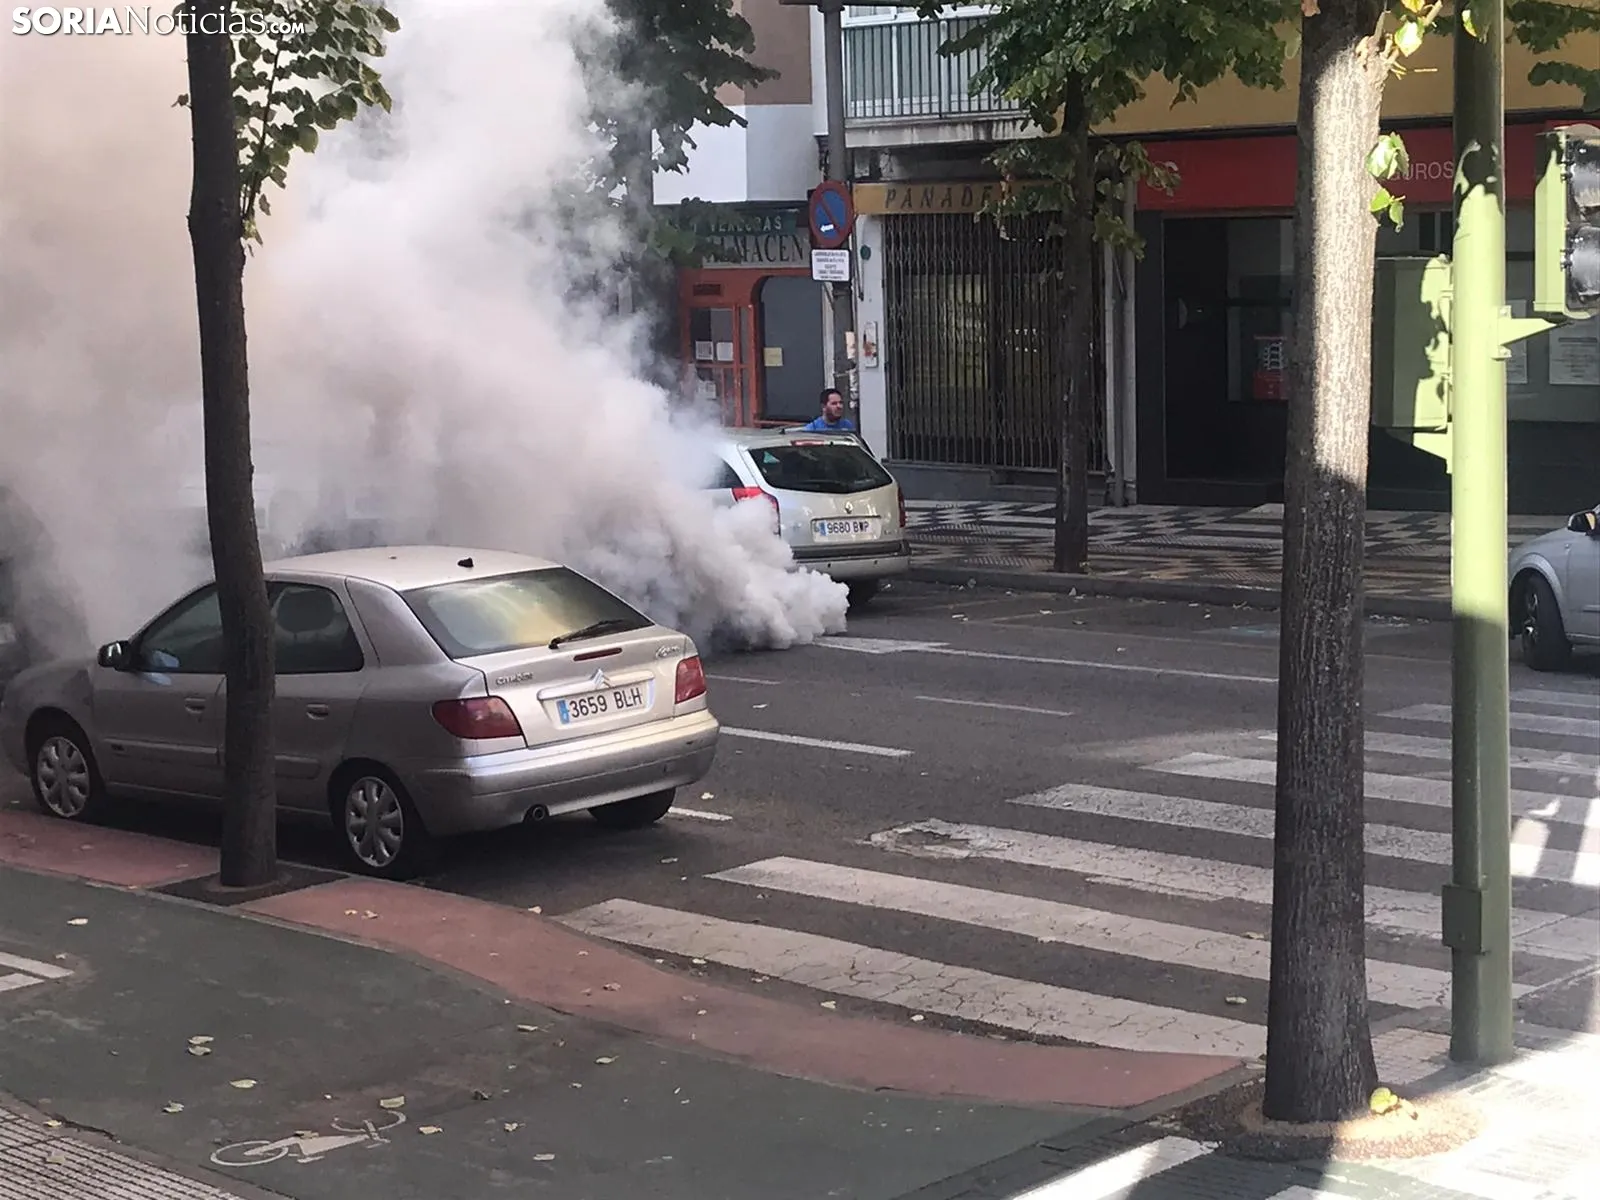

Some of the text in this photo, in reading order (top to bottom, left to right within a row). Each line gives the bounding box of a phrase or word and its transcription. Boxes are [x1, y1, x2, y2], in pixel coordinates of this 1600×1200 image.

[885, 185, 1027, 210] PANADE
[826, 522, 851, 534] 9680
[569, 687, 642, 718] 3659 BLH
